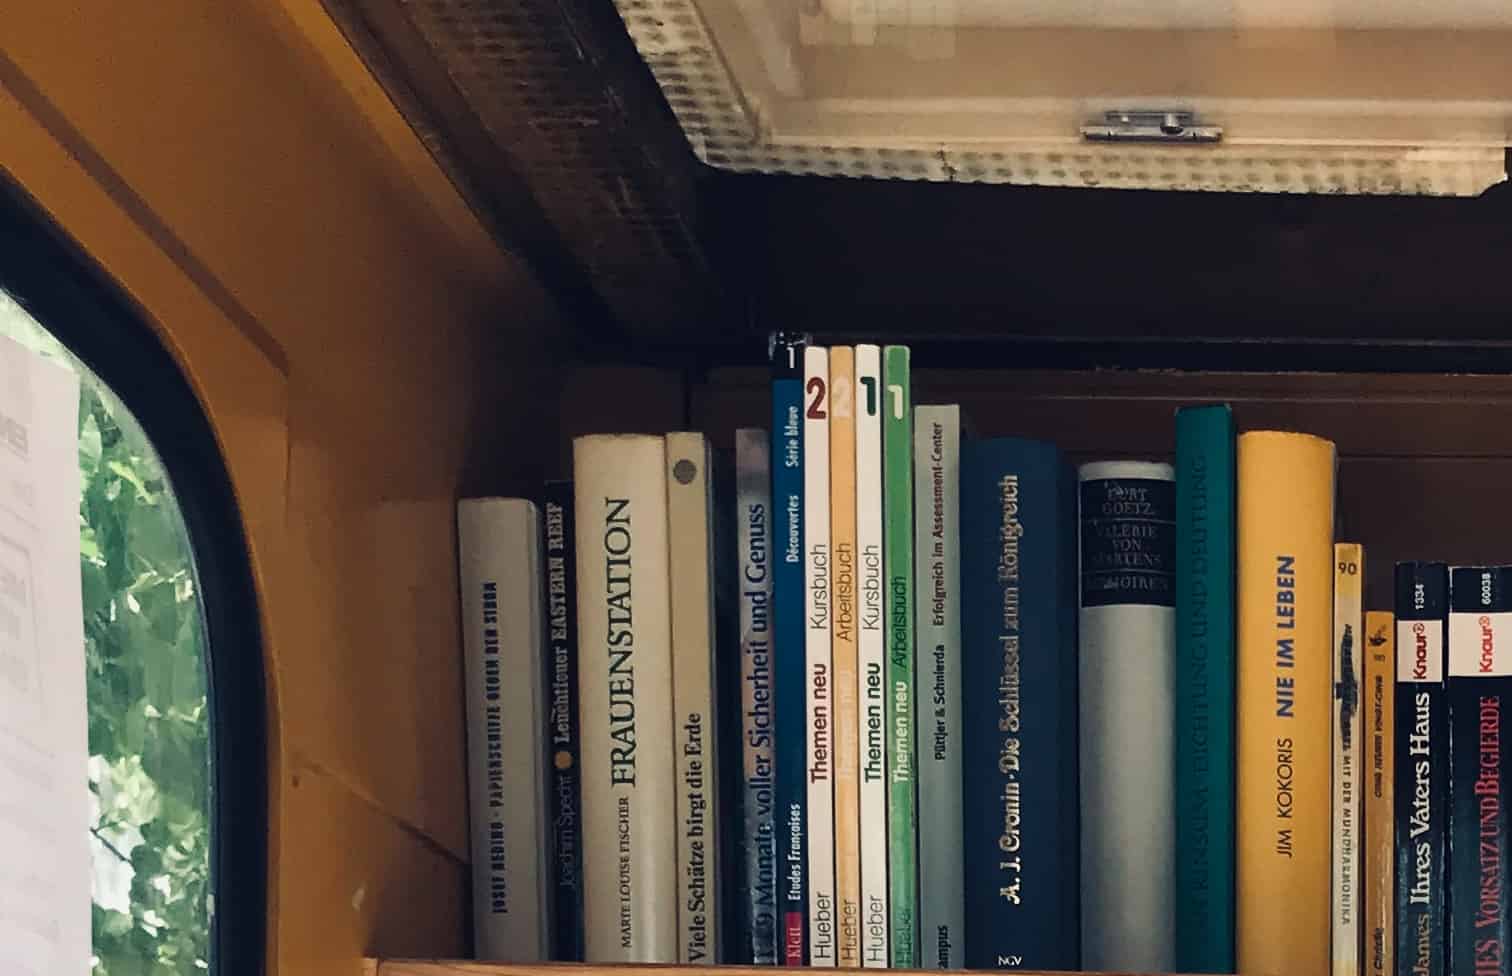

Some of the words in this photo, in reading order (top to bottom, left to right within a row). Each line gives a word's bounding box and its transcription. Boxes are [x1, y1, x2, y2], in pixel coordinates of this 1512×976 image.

[809, 544, 827, 630] Kursbuch
[1276, 555, 1295, 630] LEBEN
[603, 496, 636, 788] FRAUENSTATION
[1276, 638, 1294, 669] IM
[812, 664, 827, 698] neu
[1276, 678, 1294, 718] NIE
[683, 713, 702, 755] Erde
[810, 705, 829, 783] Themen
[684, 760, 703, 793] die
[1276, 738, 1293, 820] KOKORIS
[685, 795, 707, 838] birgt
[1276, 829, 1294, 859] JIM
[685, 841, 707, 913] Schätze
[688, 916, 706, 962] Viele
[812, 892, 833, 959] Hueber
